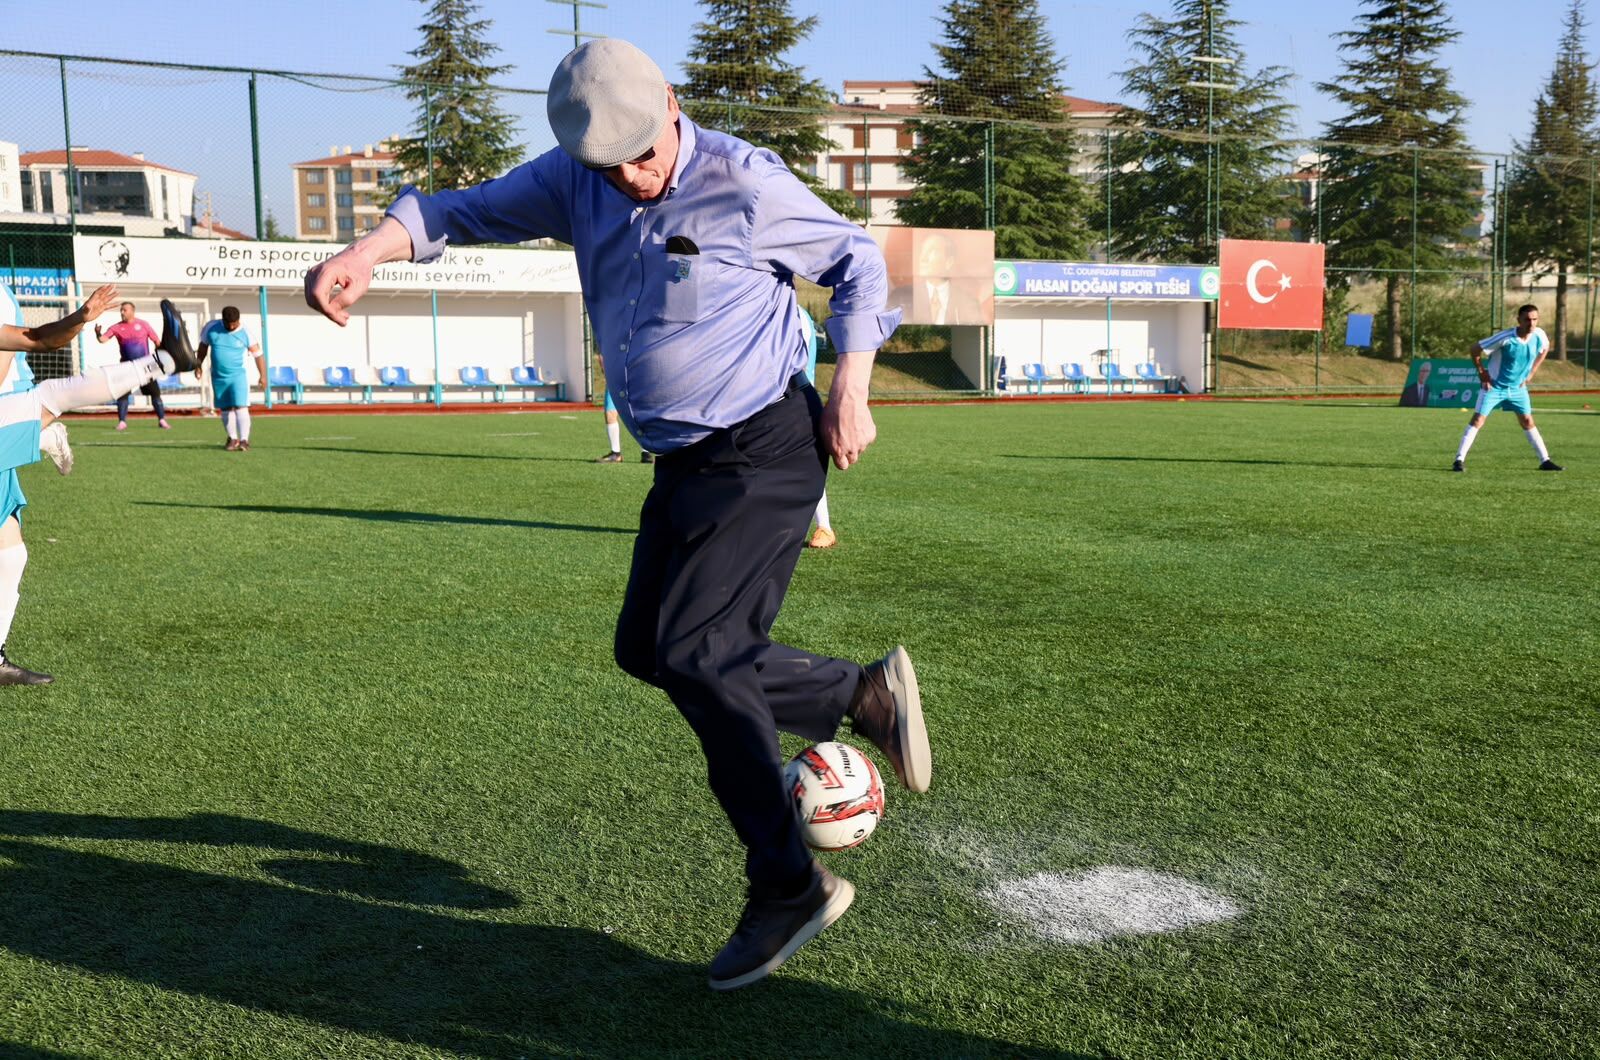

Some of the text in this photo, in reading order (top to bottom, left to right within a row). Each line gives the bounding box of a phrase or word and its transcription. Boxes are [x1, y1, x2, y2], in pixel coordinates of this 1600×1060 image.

[260, 249, 335, 263] sporcun
[464, 255, 484, 266] ve
[186, 266, 227, 280] aynı
[234, 266, 311, 279] zamand
[1025, 279, 1069, 293] HASAN
[1071, 277, 1118, 294] DOĞAN
[1119, 281, 1153, 295] SPOR
